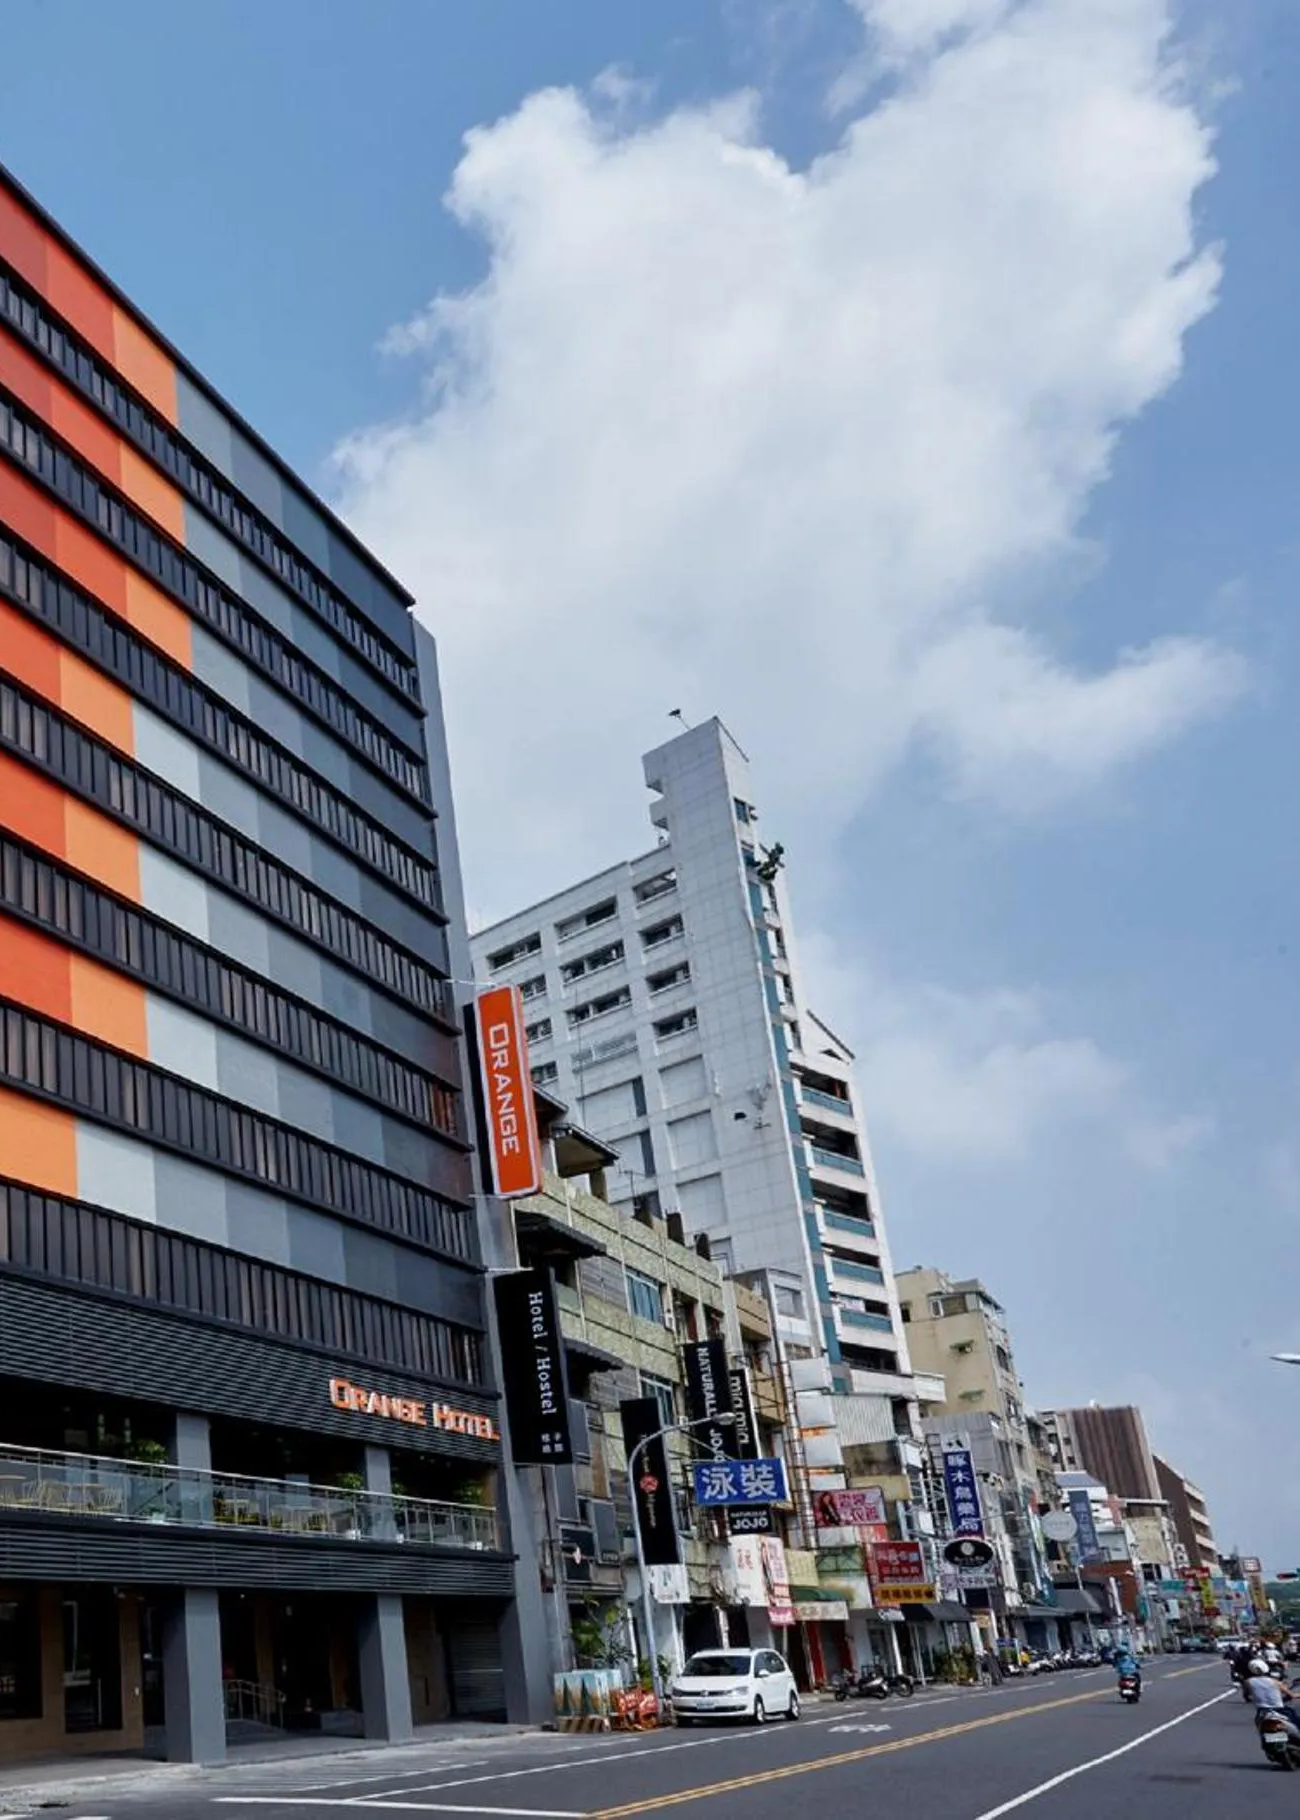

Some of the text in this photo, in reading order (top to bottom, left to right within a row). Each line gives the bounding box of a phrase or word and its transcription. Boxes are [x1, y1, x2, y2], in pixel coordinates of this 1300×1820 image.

[489, 1022, 520, 1157] ORANGE
[528, 1291, 547, 1339] Hotel
[329, 1376, 501, 1441] ORANGE HOTEL
[537, 1357, 556, 1416] Hostel
[697, 1347, 718, 1424] NATURALL
[701, 1464, 778, 1500] 泳裝
[732, 1517, 769, 1529] JOJO
